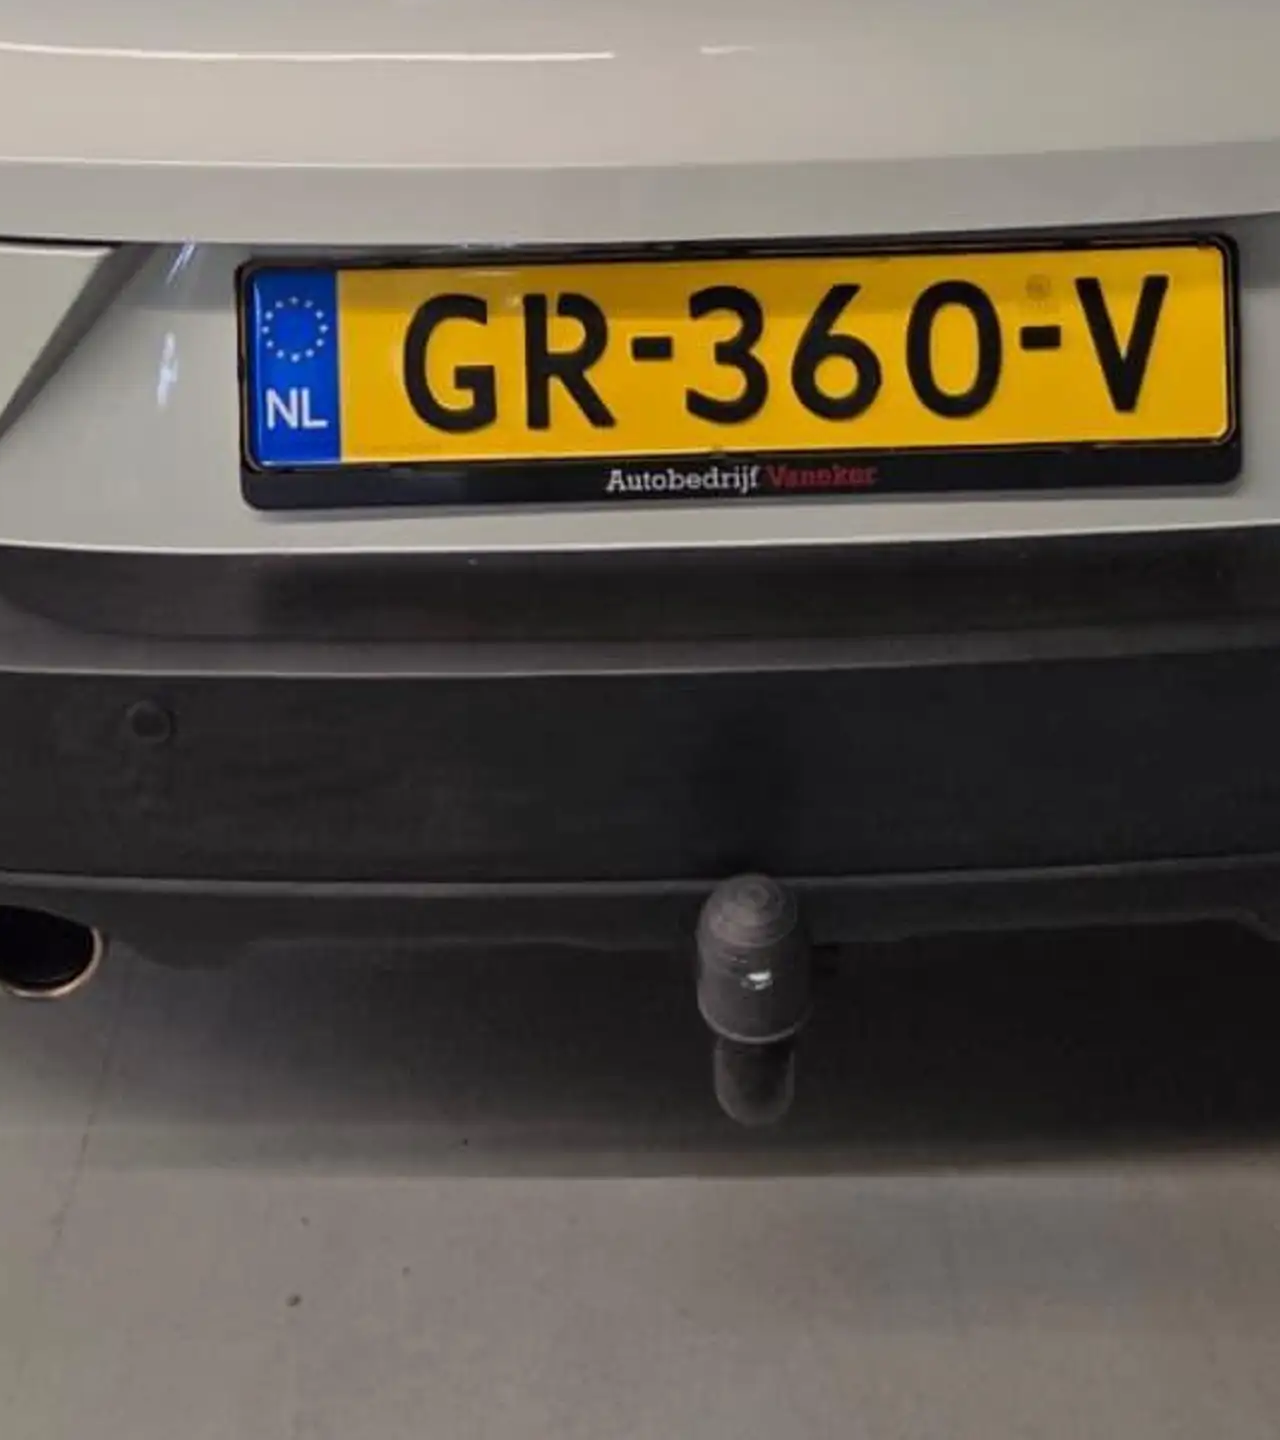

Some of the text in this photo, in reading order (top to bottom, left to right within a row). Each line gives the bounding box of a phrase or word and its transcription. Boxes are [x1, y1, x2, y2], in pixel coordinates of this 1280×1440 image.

[403, 273, 1169, 435] GR-360-V
[265, 386, 330, 431] NL
[606, 464, 879, 494] Autobedrijf Vaneker
